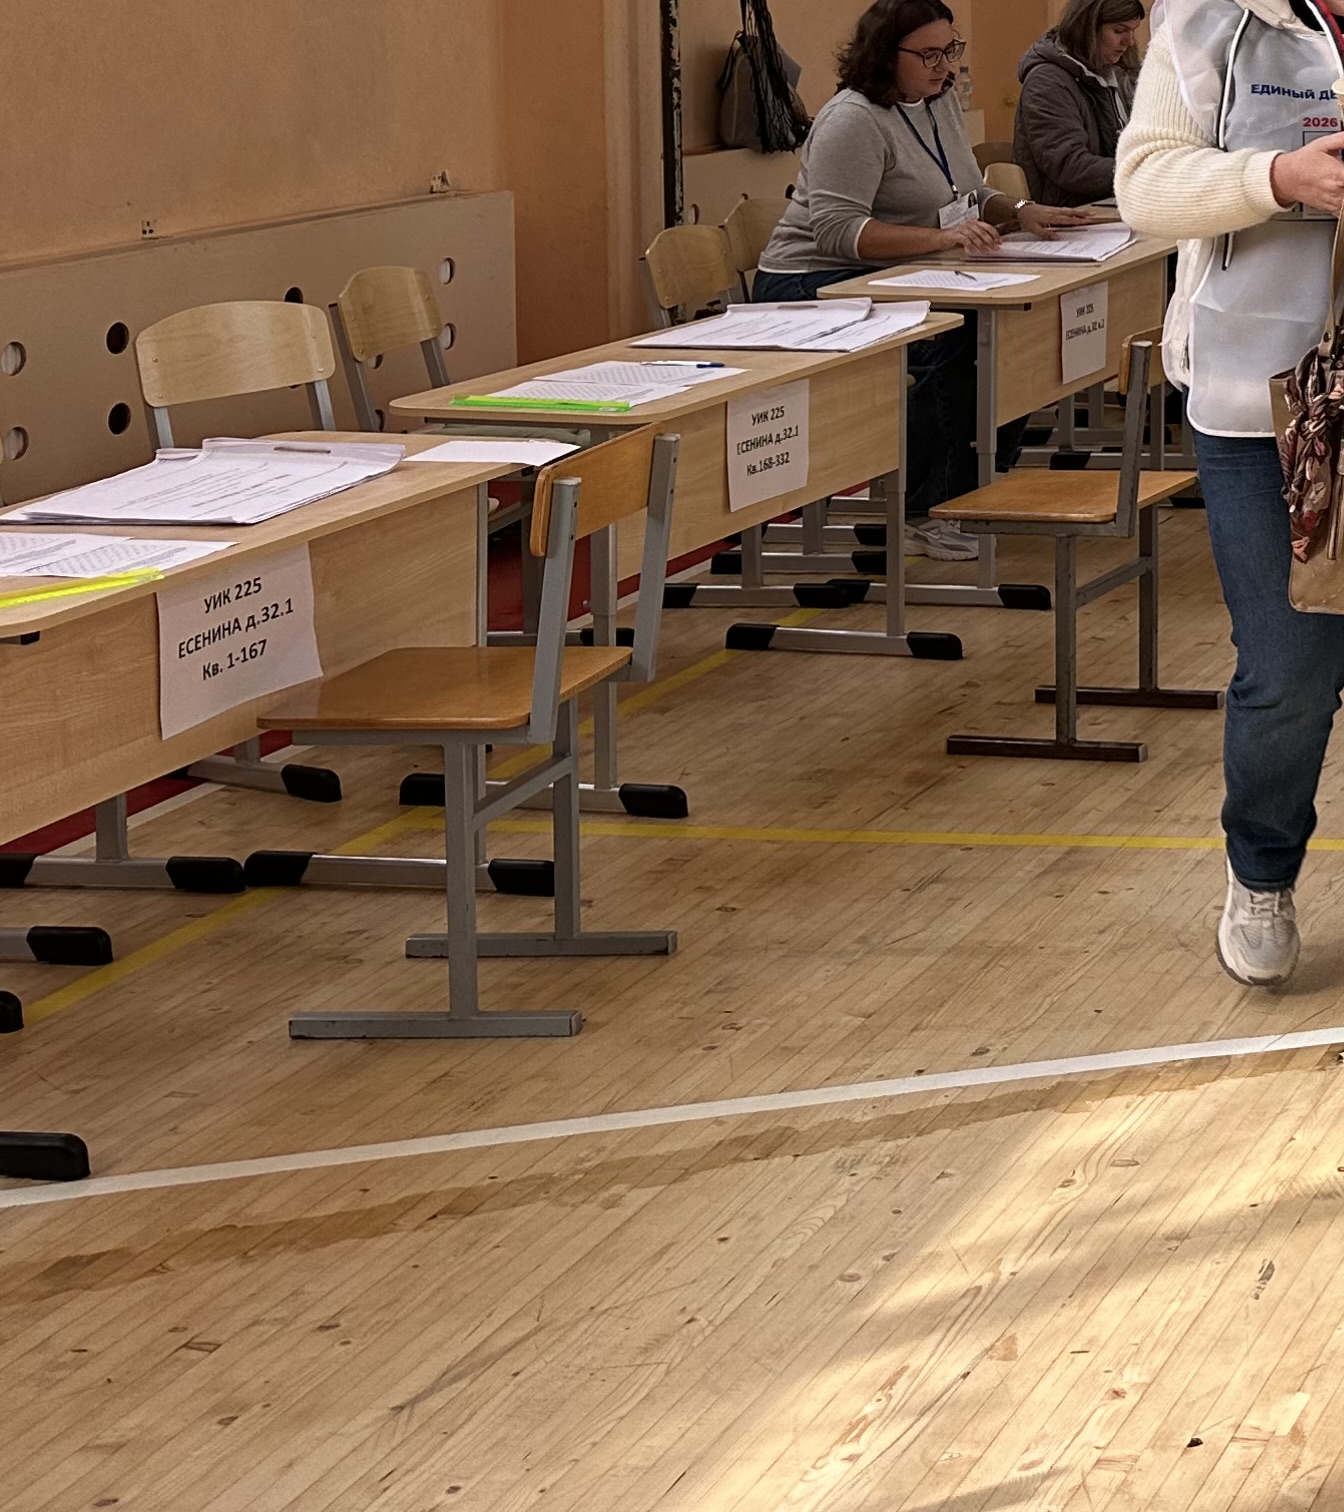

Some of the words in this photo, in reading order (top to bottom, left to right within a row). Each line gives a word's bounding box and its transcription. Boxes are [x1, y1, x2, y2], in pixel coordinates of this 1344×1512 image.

[1251, 84, 1315, 100] ЕДИНЫЙ
[1318, 89, 1338, 101] ДЕ
[1303, 117, 1339, 128] 2026
[751, 410, 769, 426] УИК
[770, 405, 785, 421] 225
[737, 433, 773, 455] ЕСЕНИНА
[775, 424, 799, 445] д.32.1
[204, 588, 232, 614] УИК
[234, 576, 263, 600] 225
[178, 617, 242, 659] ЕСЕНИНА
[245, 597, 294, 632] д.32.1
[202, 661, 223, 680] Кв.
[227, 638, 268, 669] 1-167
